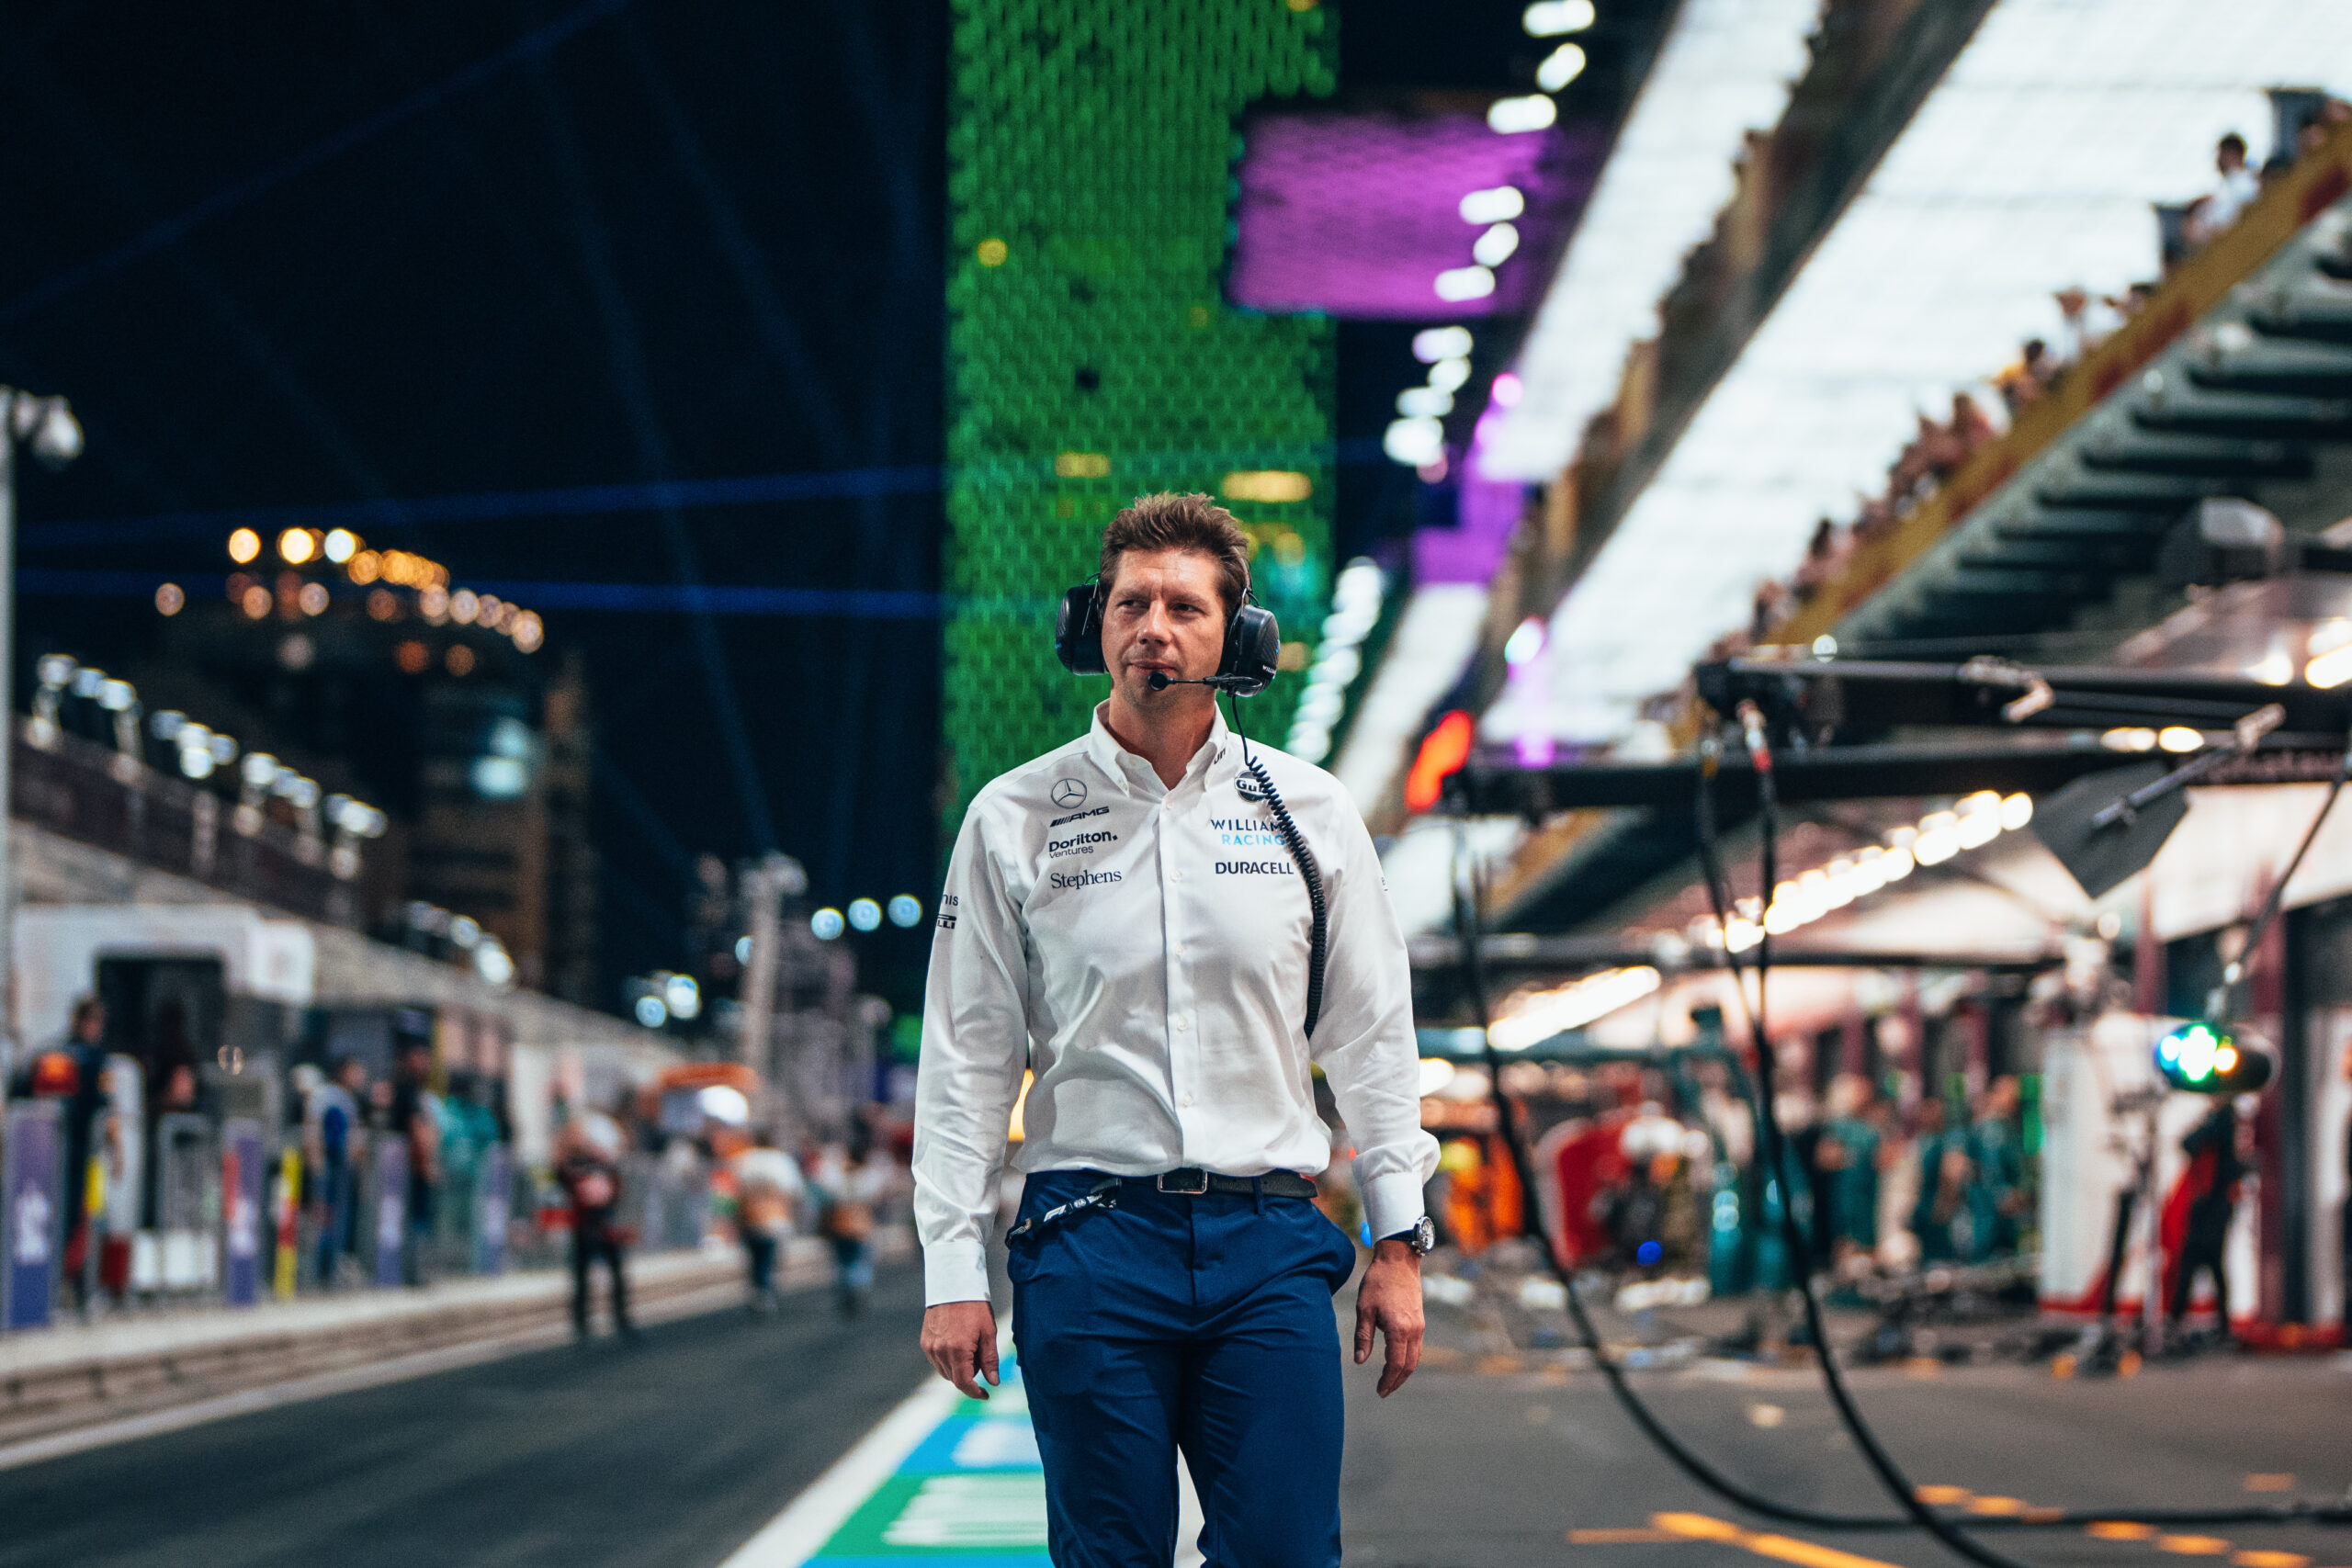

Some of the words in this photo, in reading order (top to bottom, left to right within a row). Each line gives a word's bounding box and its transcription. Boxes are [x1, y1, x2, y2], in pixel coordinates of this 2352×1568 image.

[1236, 779, 1262, 793] Gul
[1069, 806, 1110, 823] AMG
[1210, 818, 1283, 832] WILLIAM
[1221, 833, 1286, 846] RACING
[1215, 862, 1295, 874] DURACELL
[1050, 869, 1123, 890] Stephens
